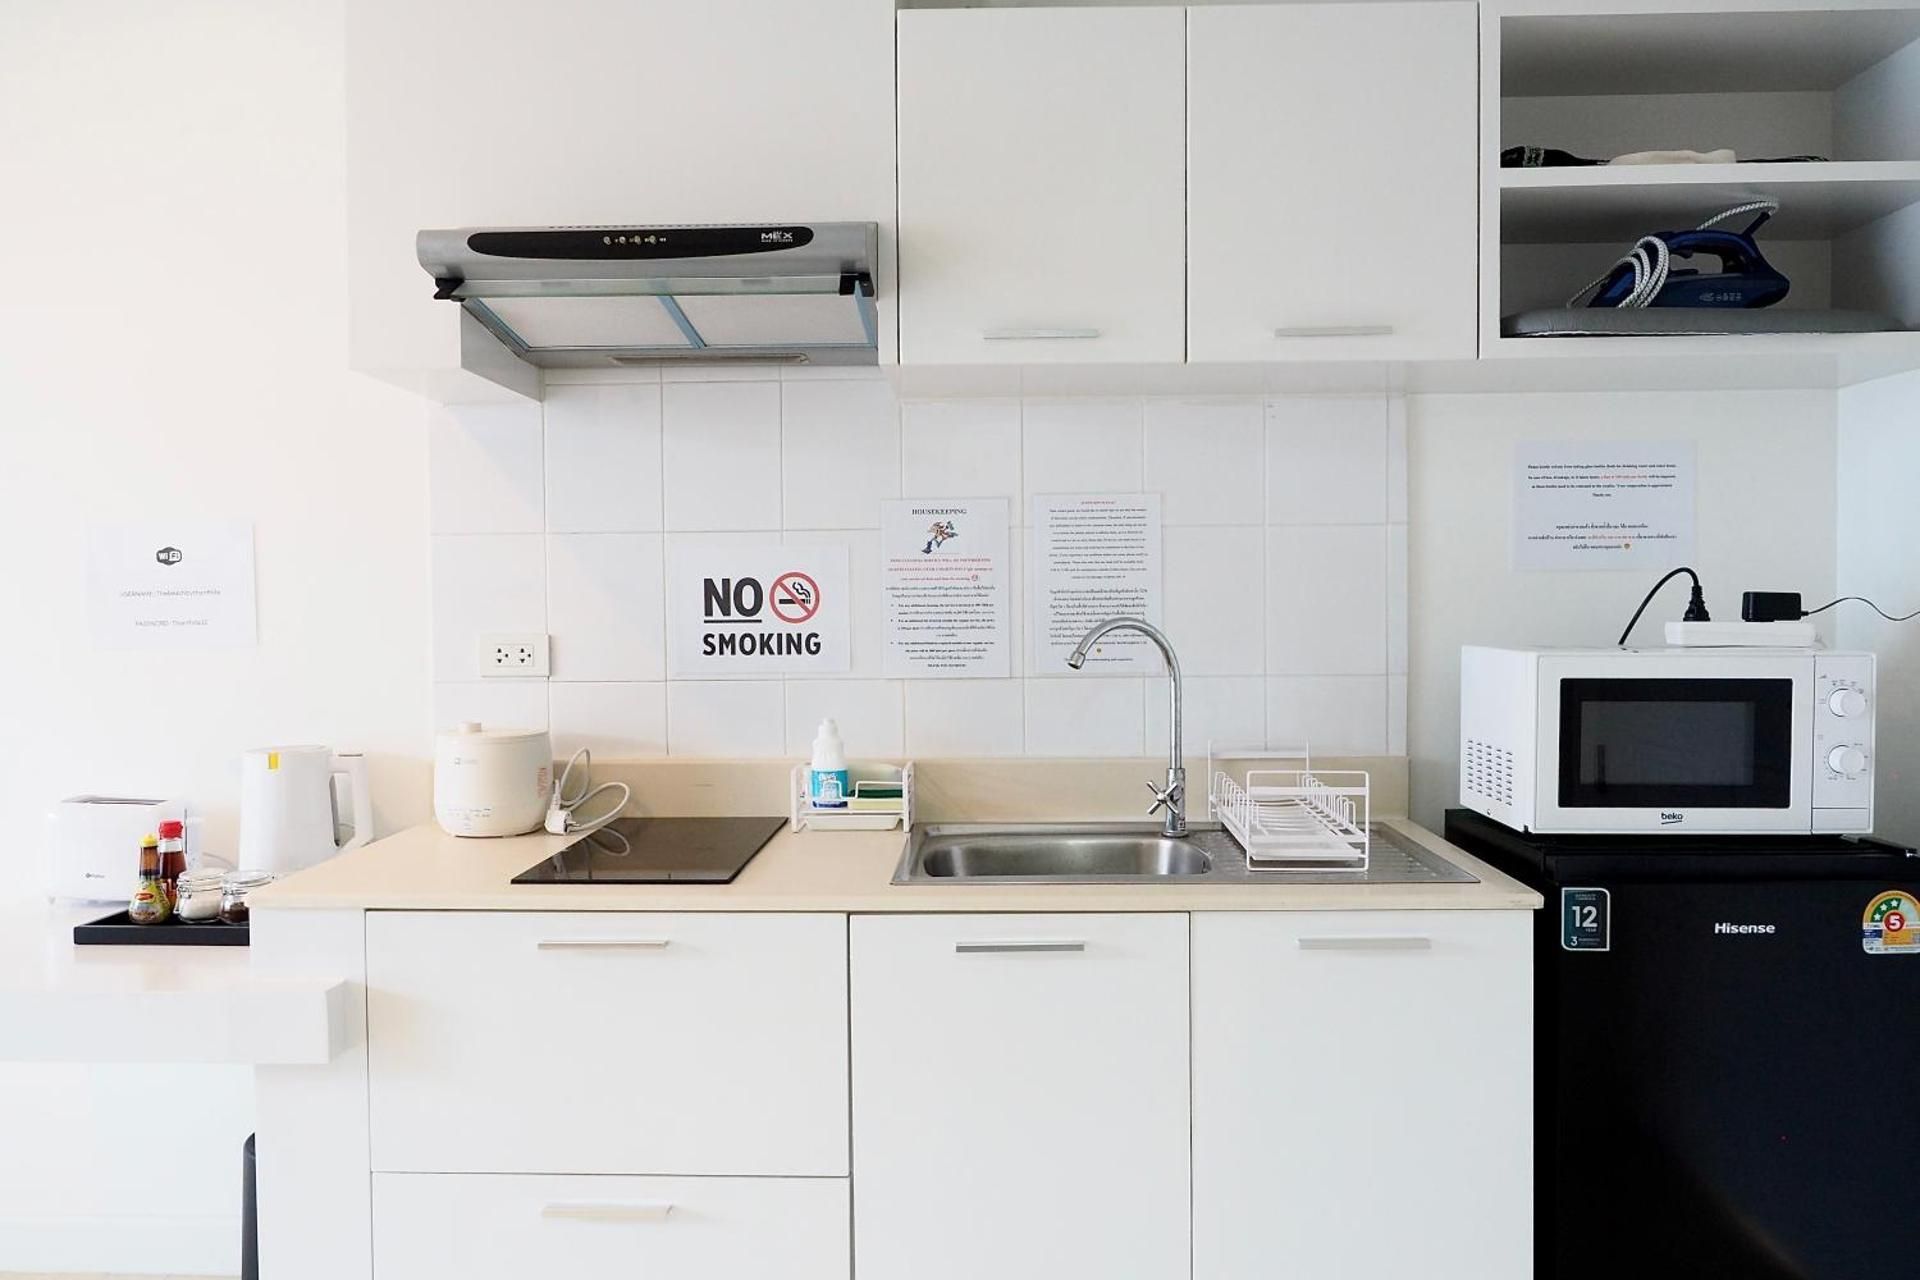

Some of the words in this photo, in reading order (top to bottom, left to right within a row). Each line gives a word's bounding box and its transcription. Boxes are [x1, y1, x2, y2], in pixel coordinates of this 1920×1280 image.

[703, 577, 764, 617] NO
[702, 632, 822, 656] SMOKING
[1660, 812, 1683, 820] beko
[1571, 905, 1598, 928] 12
[1889, 914, 1901, 930] 5
[1714, 922, 1776, 934] Hisense
[1570, 936, 1578, 946] 3
